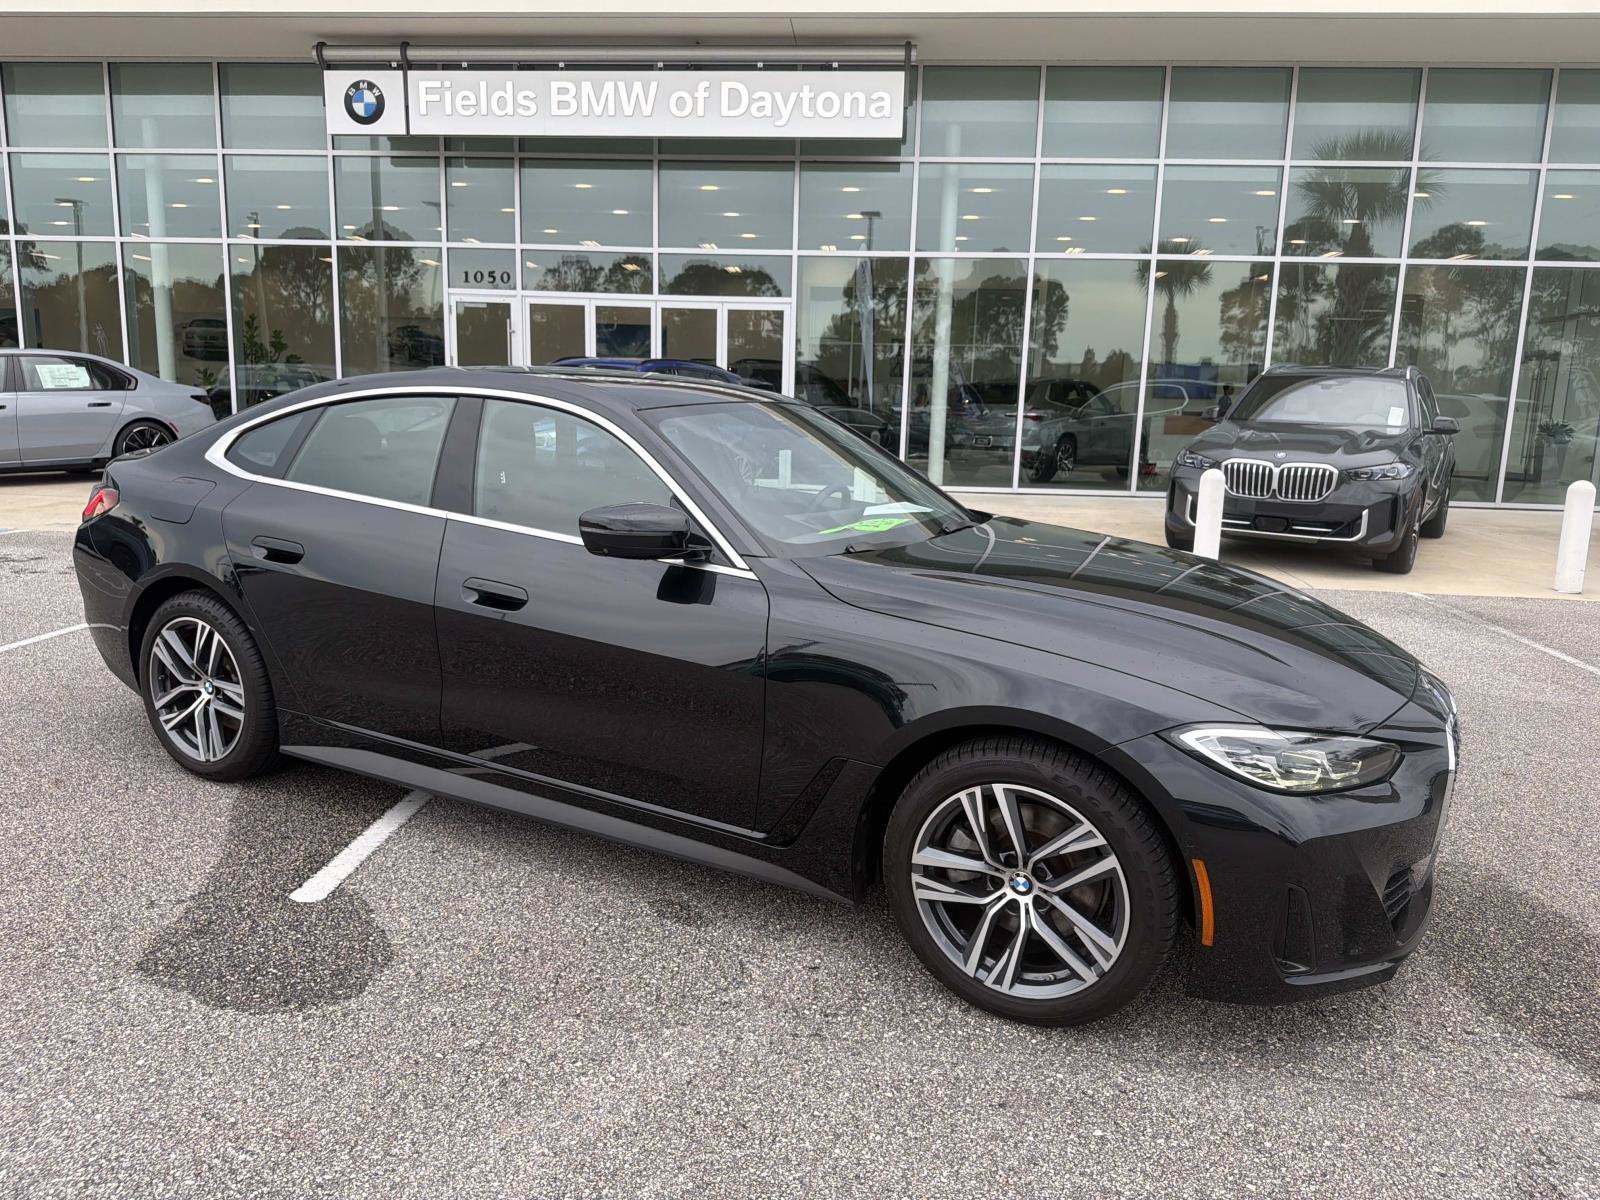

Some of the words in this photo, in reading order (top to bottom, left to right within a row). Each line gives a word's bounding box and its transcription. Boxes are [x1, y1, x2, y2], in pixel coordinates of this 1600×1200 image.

[347, 81, 381, 96] BMW
[418, 80, 538, 117] Fields
[550, 80, 659, 118] BMW
[668, 81, 711, 118] of
[720, 81, 892, 127] Daytona
[463, 270, 511, 284] 1050
